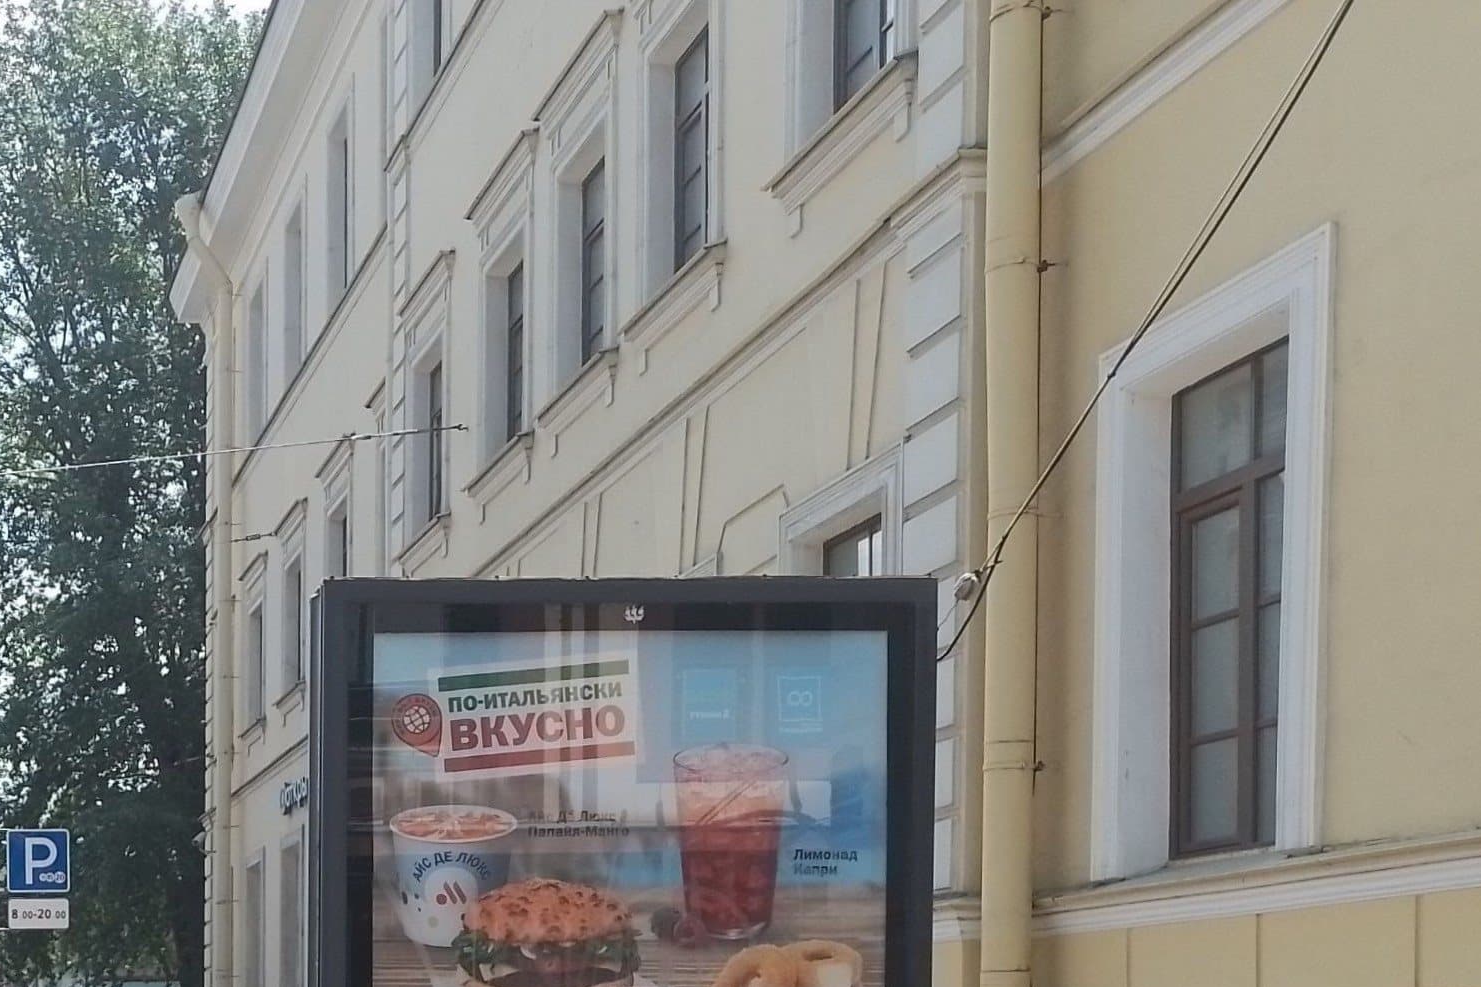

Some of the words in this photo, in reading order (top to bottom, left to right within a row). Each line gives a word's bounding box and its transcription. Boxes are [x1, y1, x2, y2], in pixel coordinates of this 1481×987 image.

[448, 681, 623, 713] ПО-ИТАЛЬЯНСКИ
[450, 704, 625, 751] ВКУСНО
[25, 837, 57, 885] P
[433, 851, 453, 866] ДЕ
[794, 848, 858, 862] Лимонад
[793, 863, 838, 877] Капри
